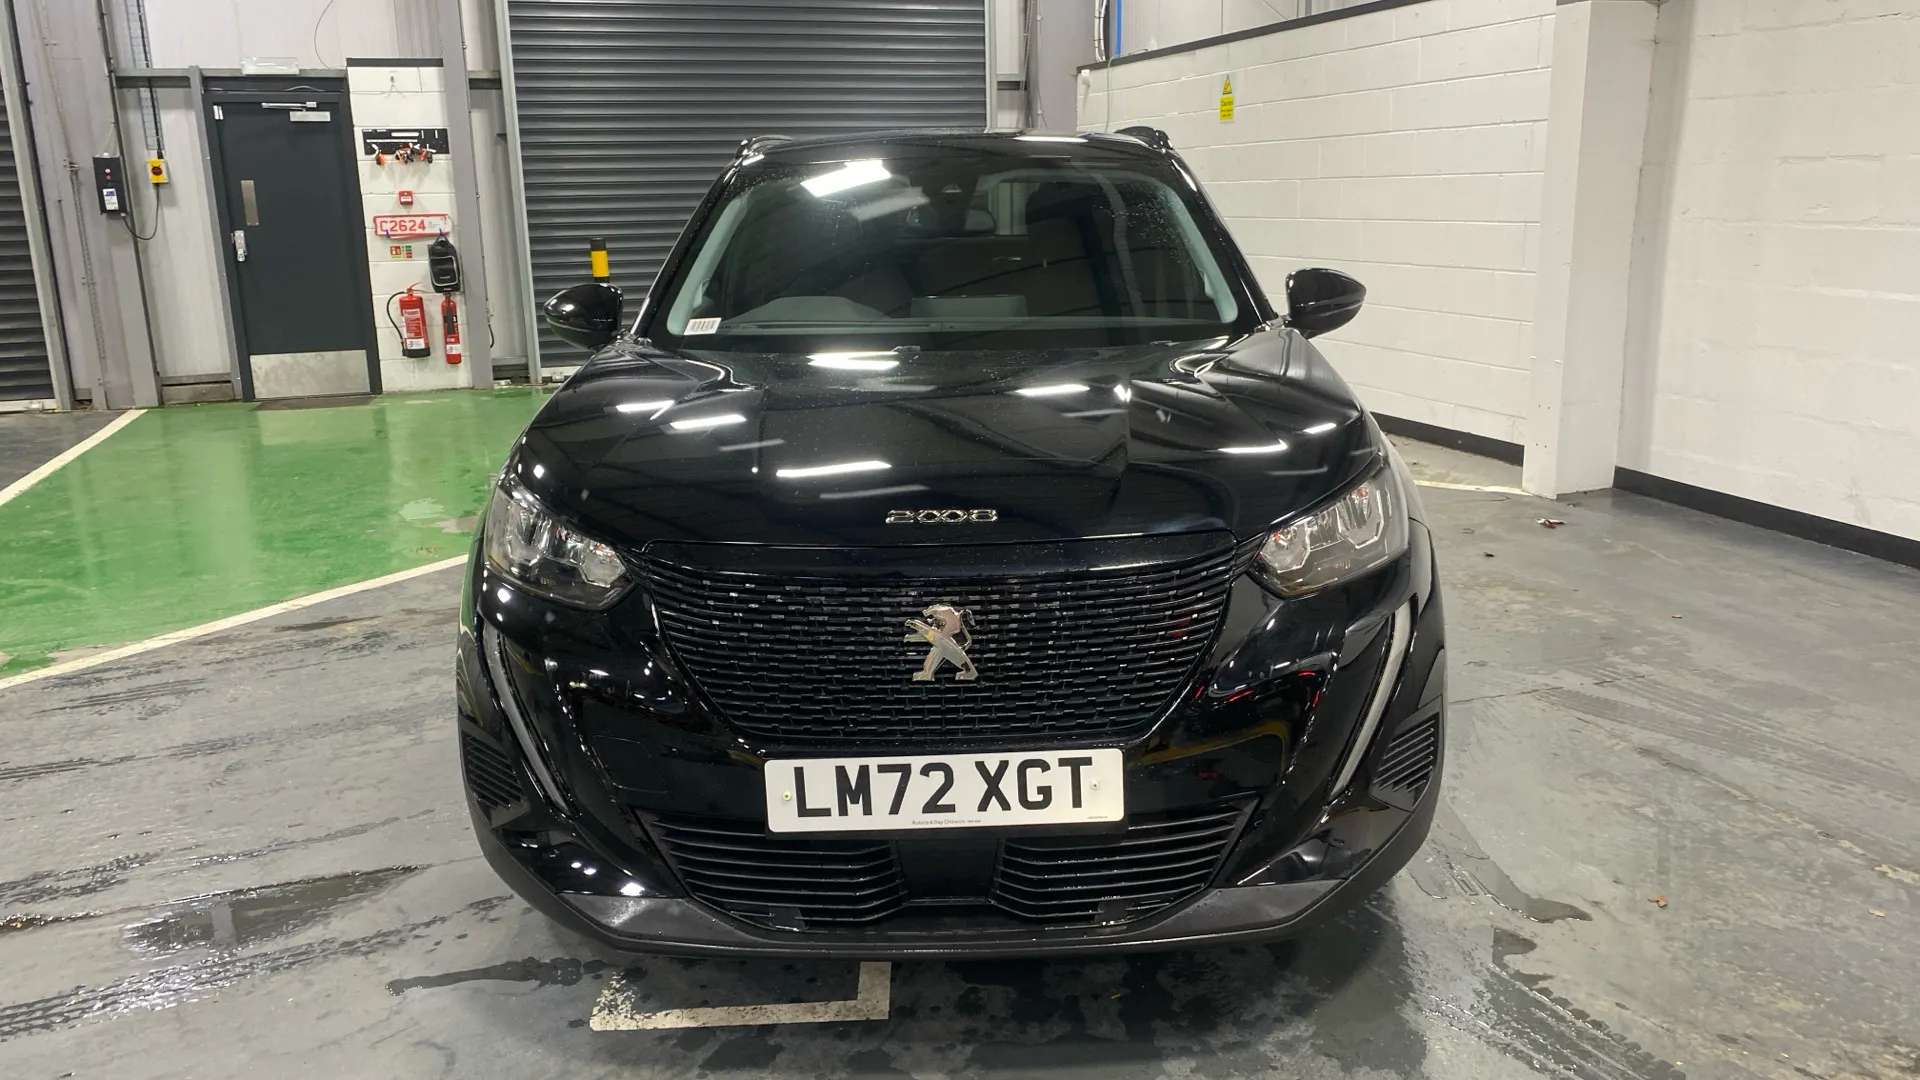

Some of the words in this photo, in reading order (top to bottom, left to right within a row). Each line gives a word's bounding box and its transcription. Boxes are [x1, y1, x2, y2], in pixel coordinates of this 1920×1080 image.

[885, 509, 998, 524] 2008
[793, 762, 956, 818] LM72
[974, 756, 1094, 813] XGT
